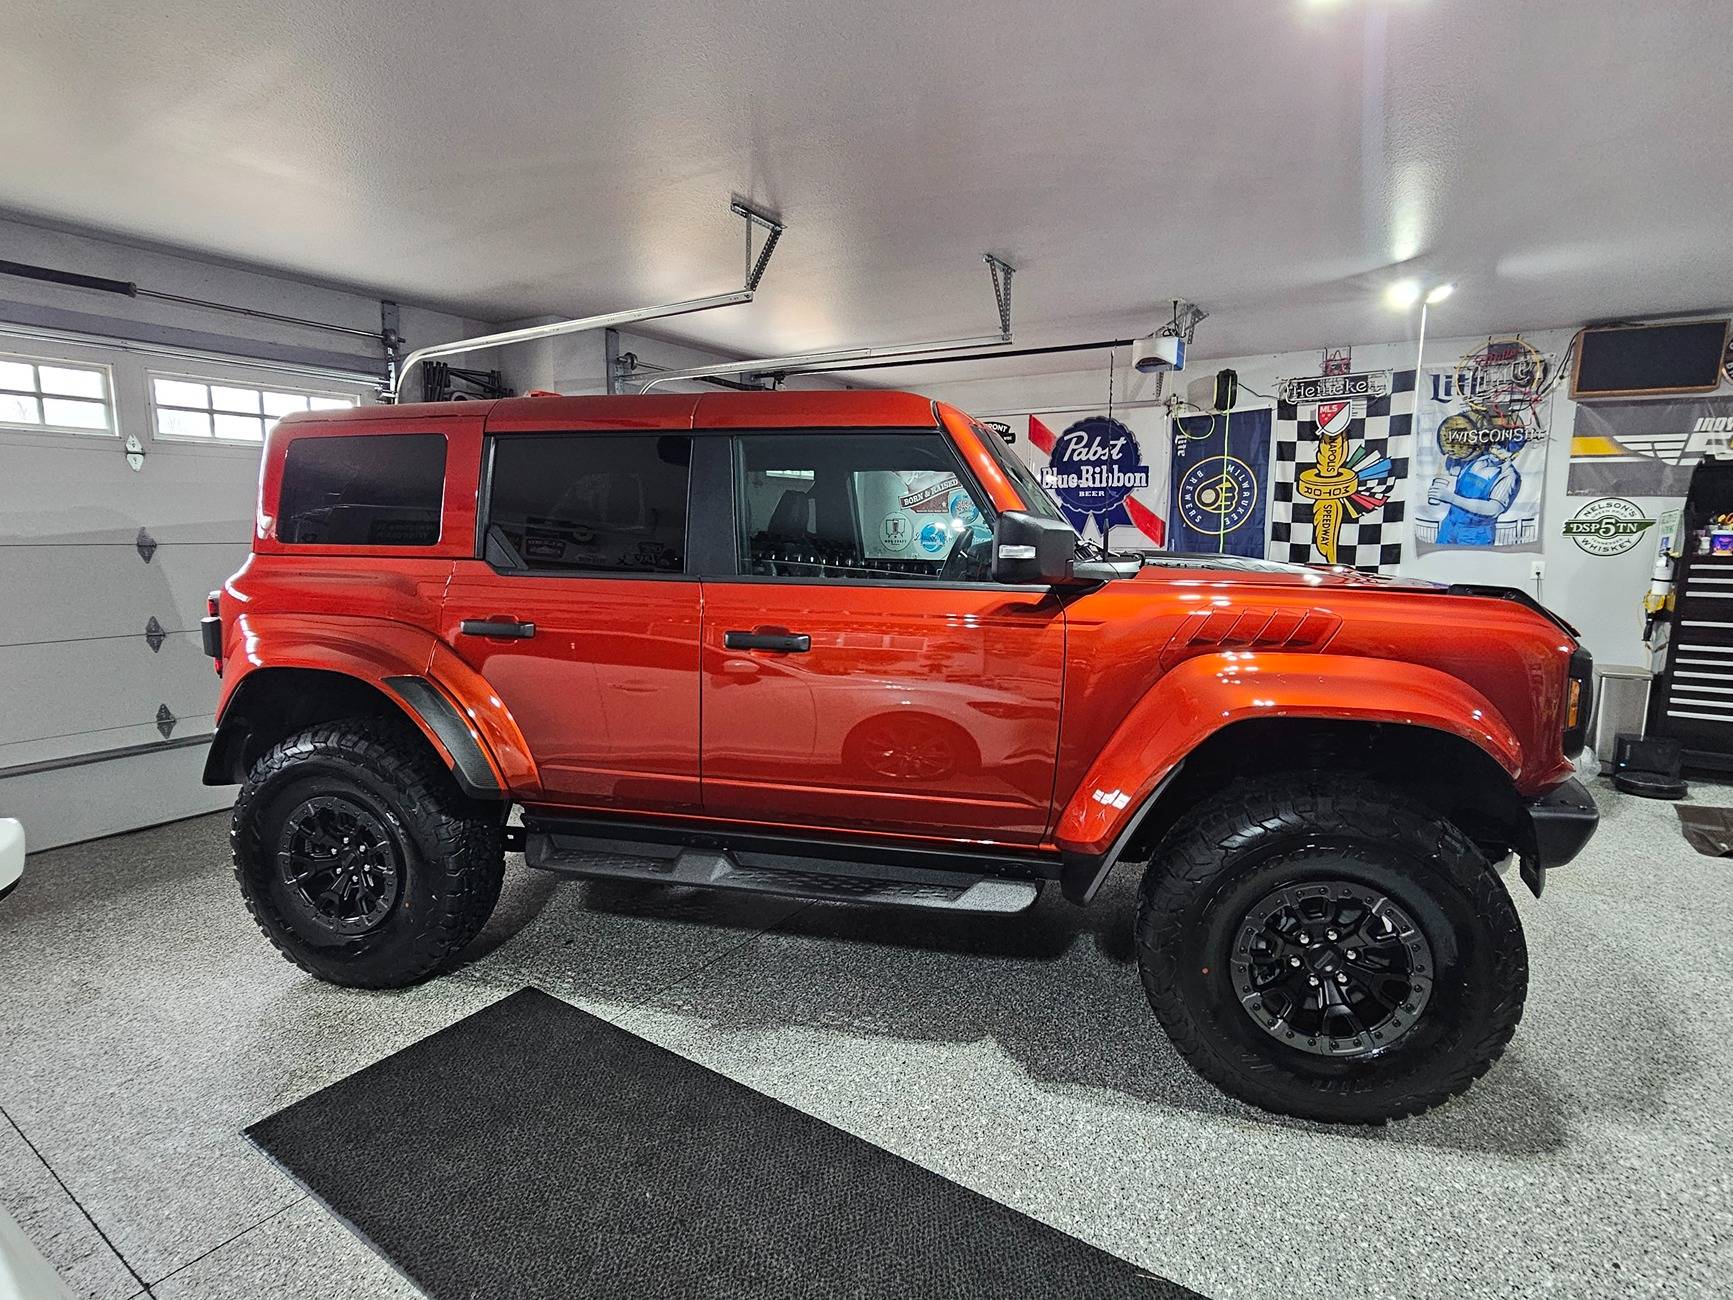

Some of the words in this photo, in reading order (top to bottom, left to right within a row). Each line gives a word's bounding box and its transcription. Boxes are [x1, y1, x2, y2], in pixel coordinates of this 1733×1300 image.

[1320, 405, 1338, 413] MLS
[1063, 431, 1126, 462] Pabst
[1041, 467, 1078, 489] Blue
[1078, 465, 1148, 488] Ribbon
[903, 492, 924, 506] BORN
[930, 479, 959, 495] RAISED
[1184, 470, 1204, 523] BREWERS
[1226, 464, 1250, 526] MILWAUKEE
[1584, 501, 1638, 517] NELSON'S
[1320, 504, 1333, 546] SPEEDWAY
[1581, 538, 1632, 552] WHISKEY
